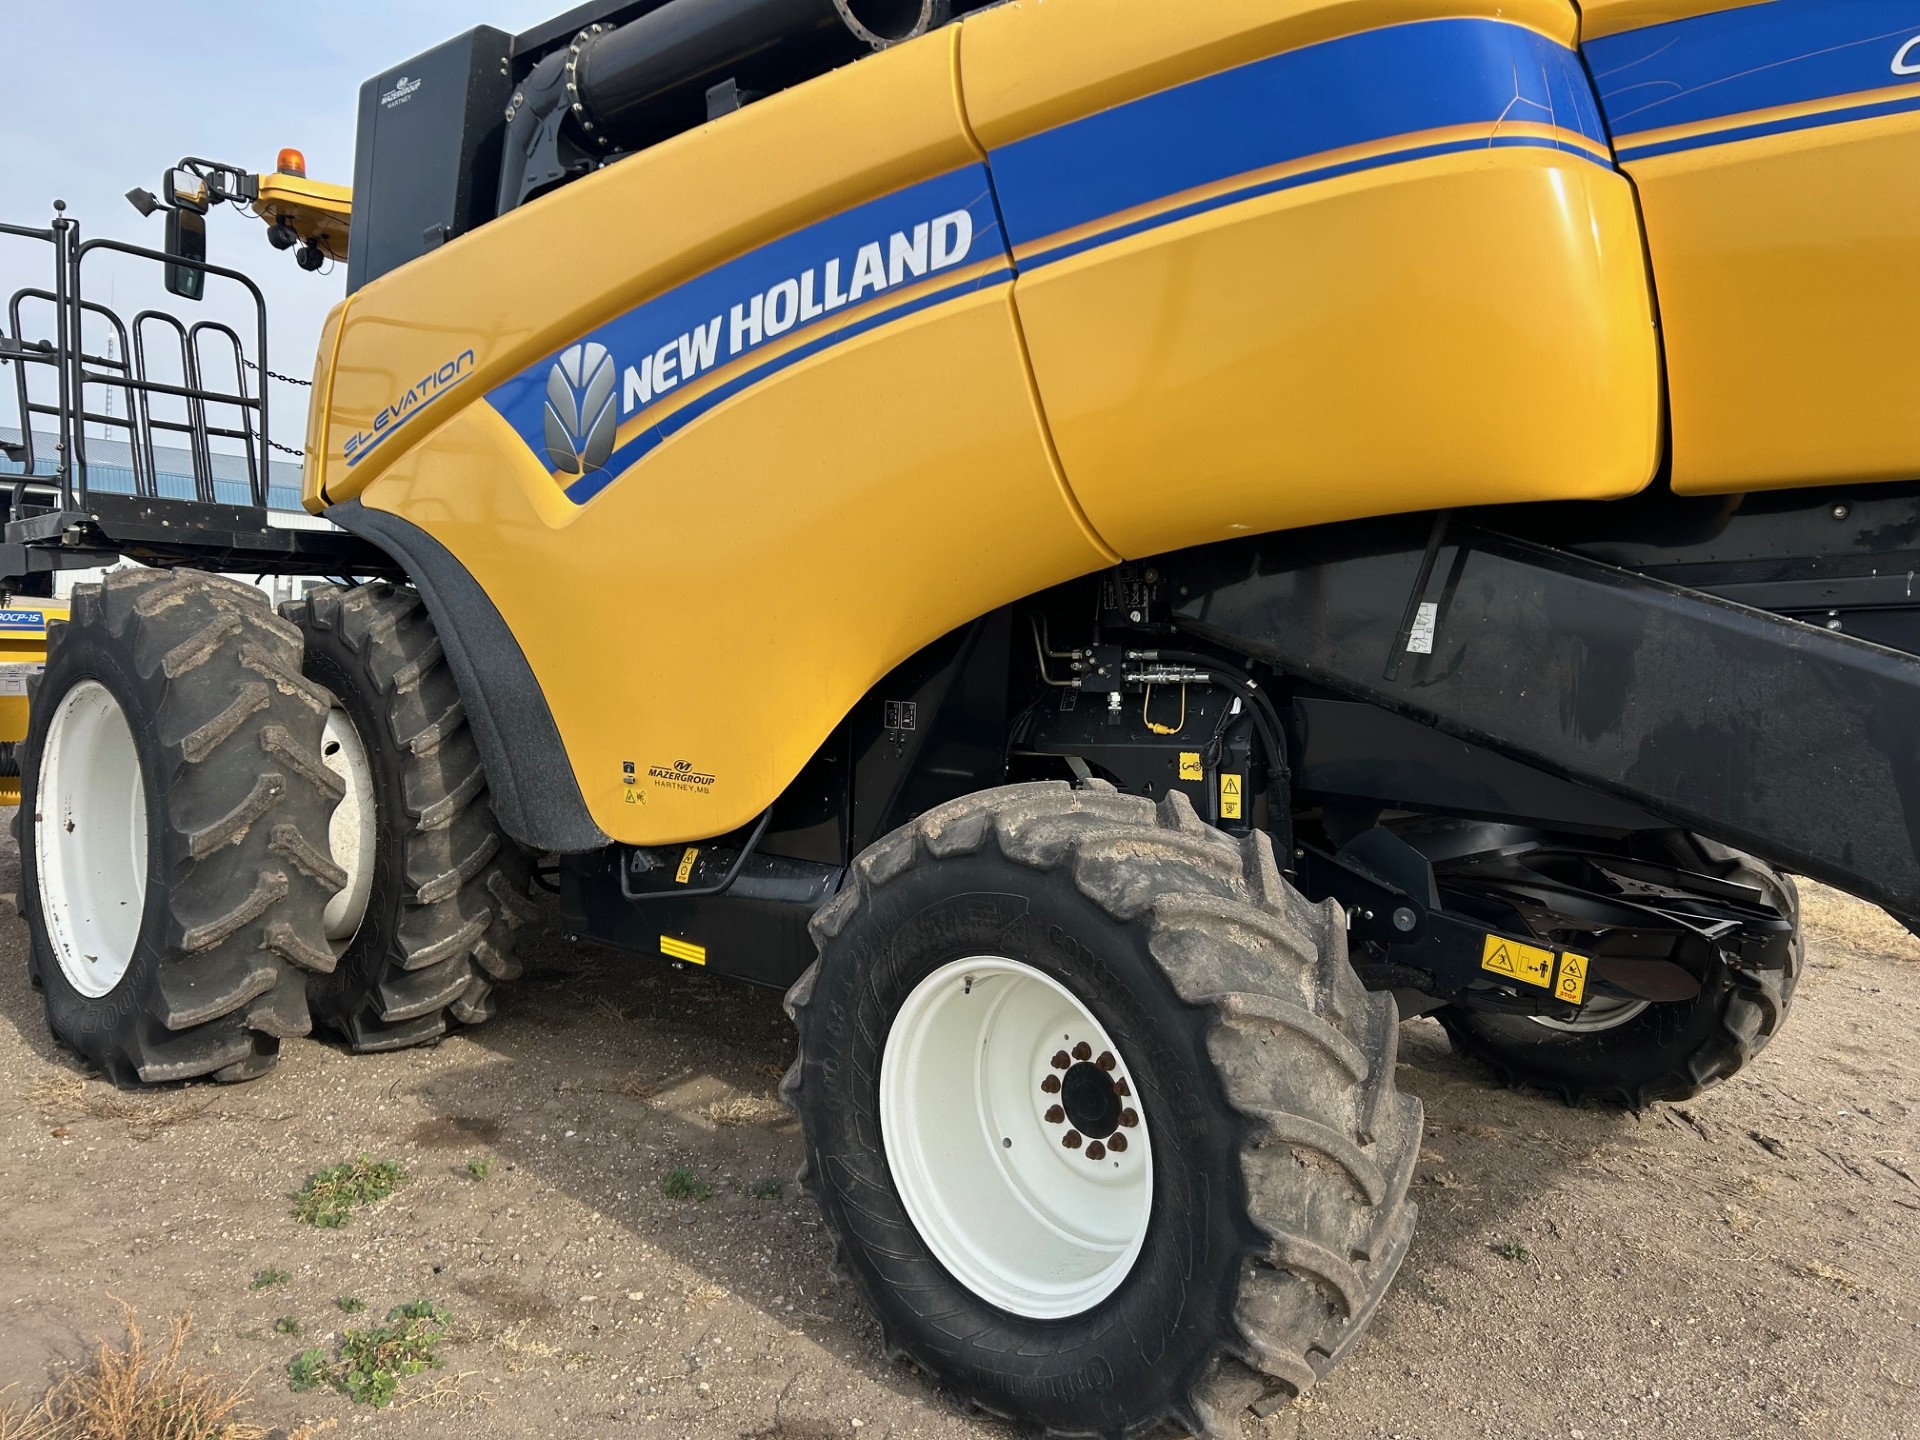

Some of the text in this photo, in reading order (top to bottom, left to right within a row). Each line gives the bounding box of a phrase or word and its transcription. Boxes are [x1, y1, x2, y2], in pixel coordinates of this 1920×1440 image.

[387, 95, 411, 109] HARTNEY
[623, 208, 973, 415] NEW HOLLAND
[343, 348, 474, 459] ELEVATION
[648, 768, 715, 786] MAZERGROUP
[1559, 990, 1577, 1000] STOP
